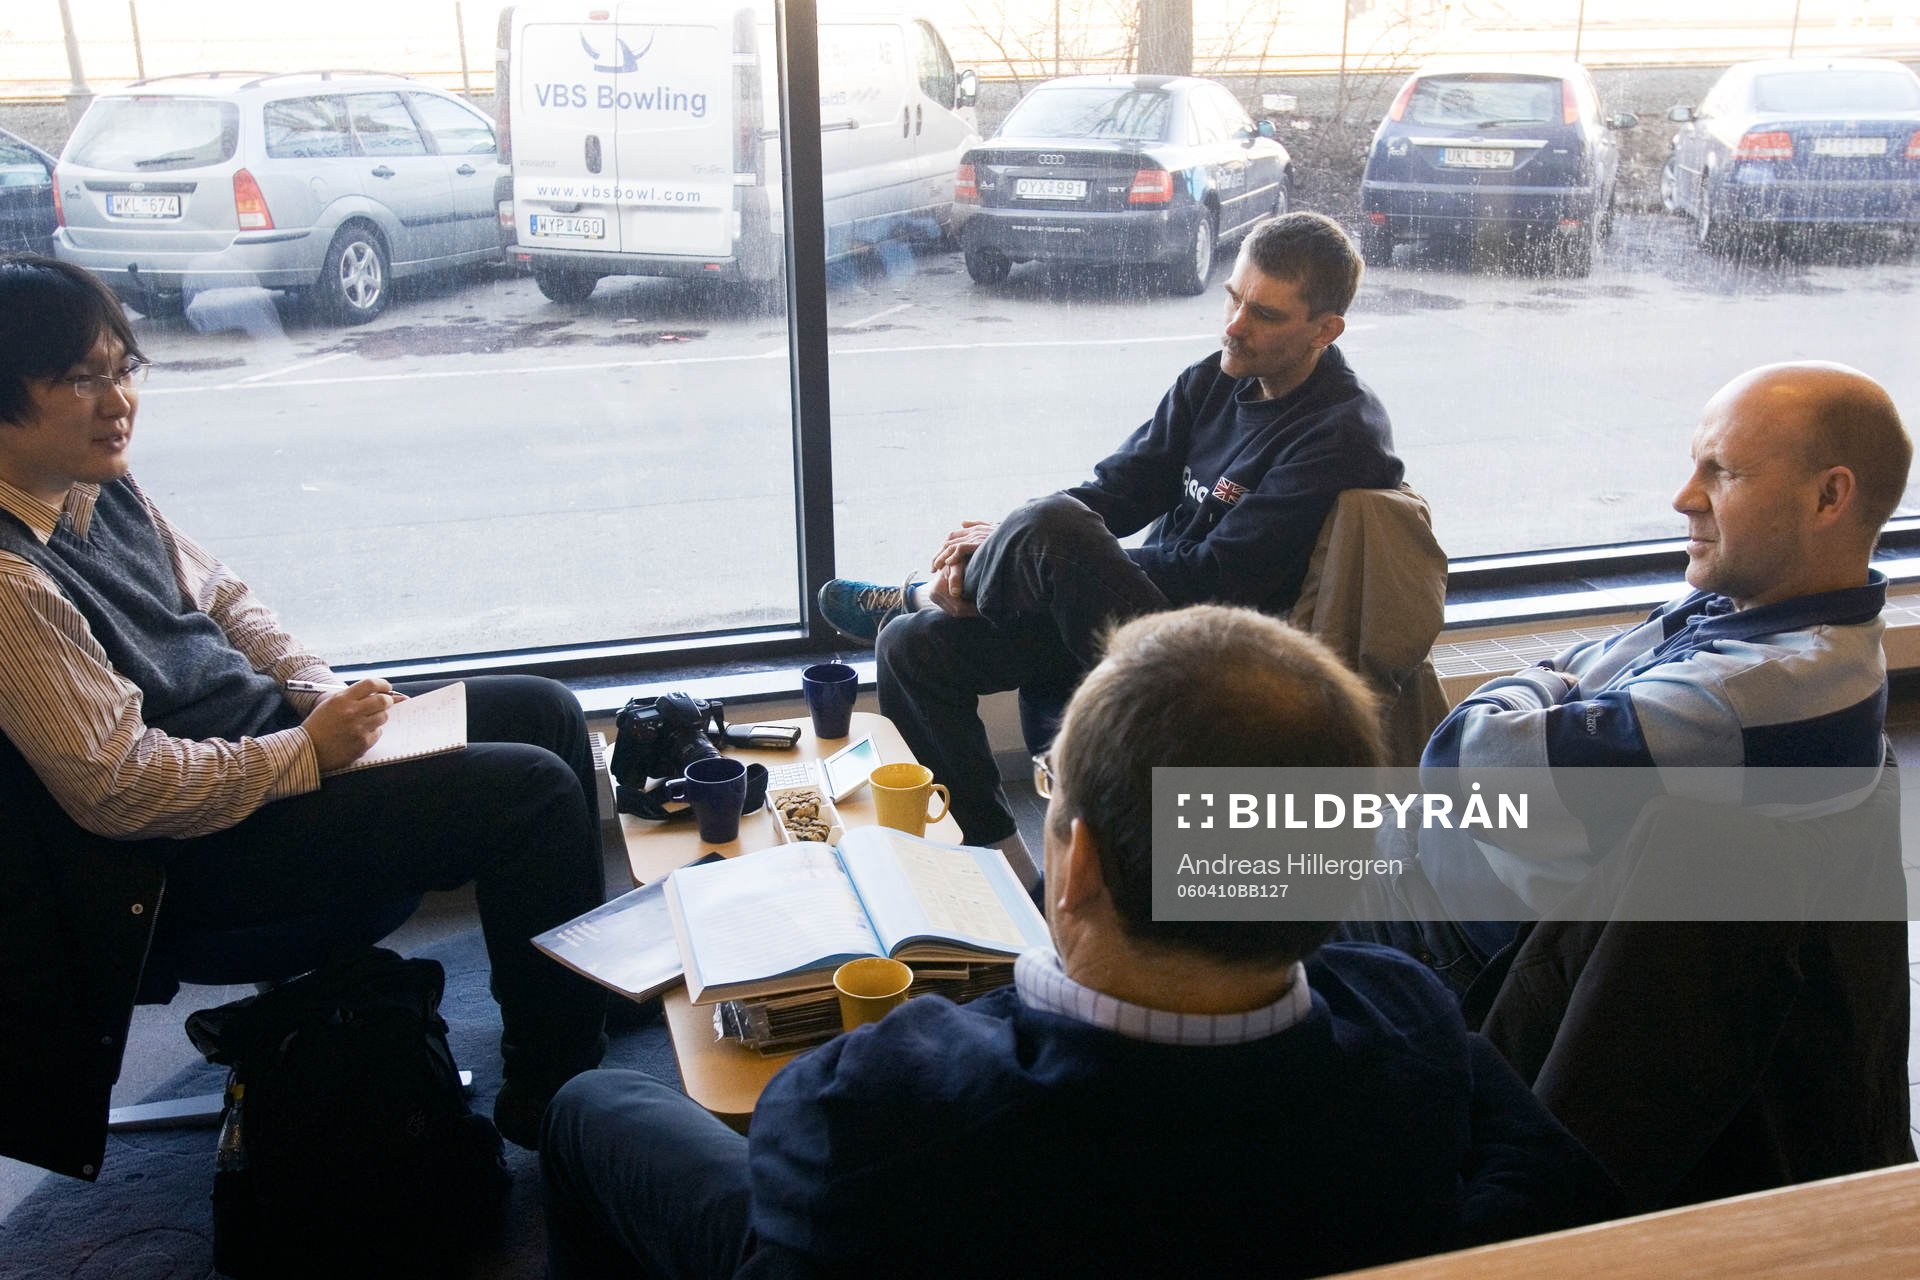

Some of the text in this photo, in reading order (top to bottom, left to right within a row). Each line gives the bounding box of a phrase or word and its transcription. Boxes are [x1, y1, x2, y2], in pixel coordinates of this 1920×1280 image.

[535, 83, 707, 118] VBS Bowling
[536, 183, 702, 203] www.vbsbowl.com
[1057, 182, 1082, 194] 991
[115, 198, 175, 212] WKL 674
[540, 216, 600, 234] WYP 460
